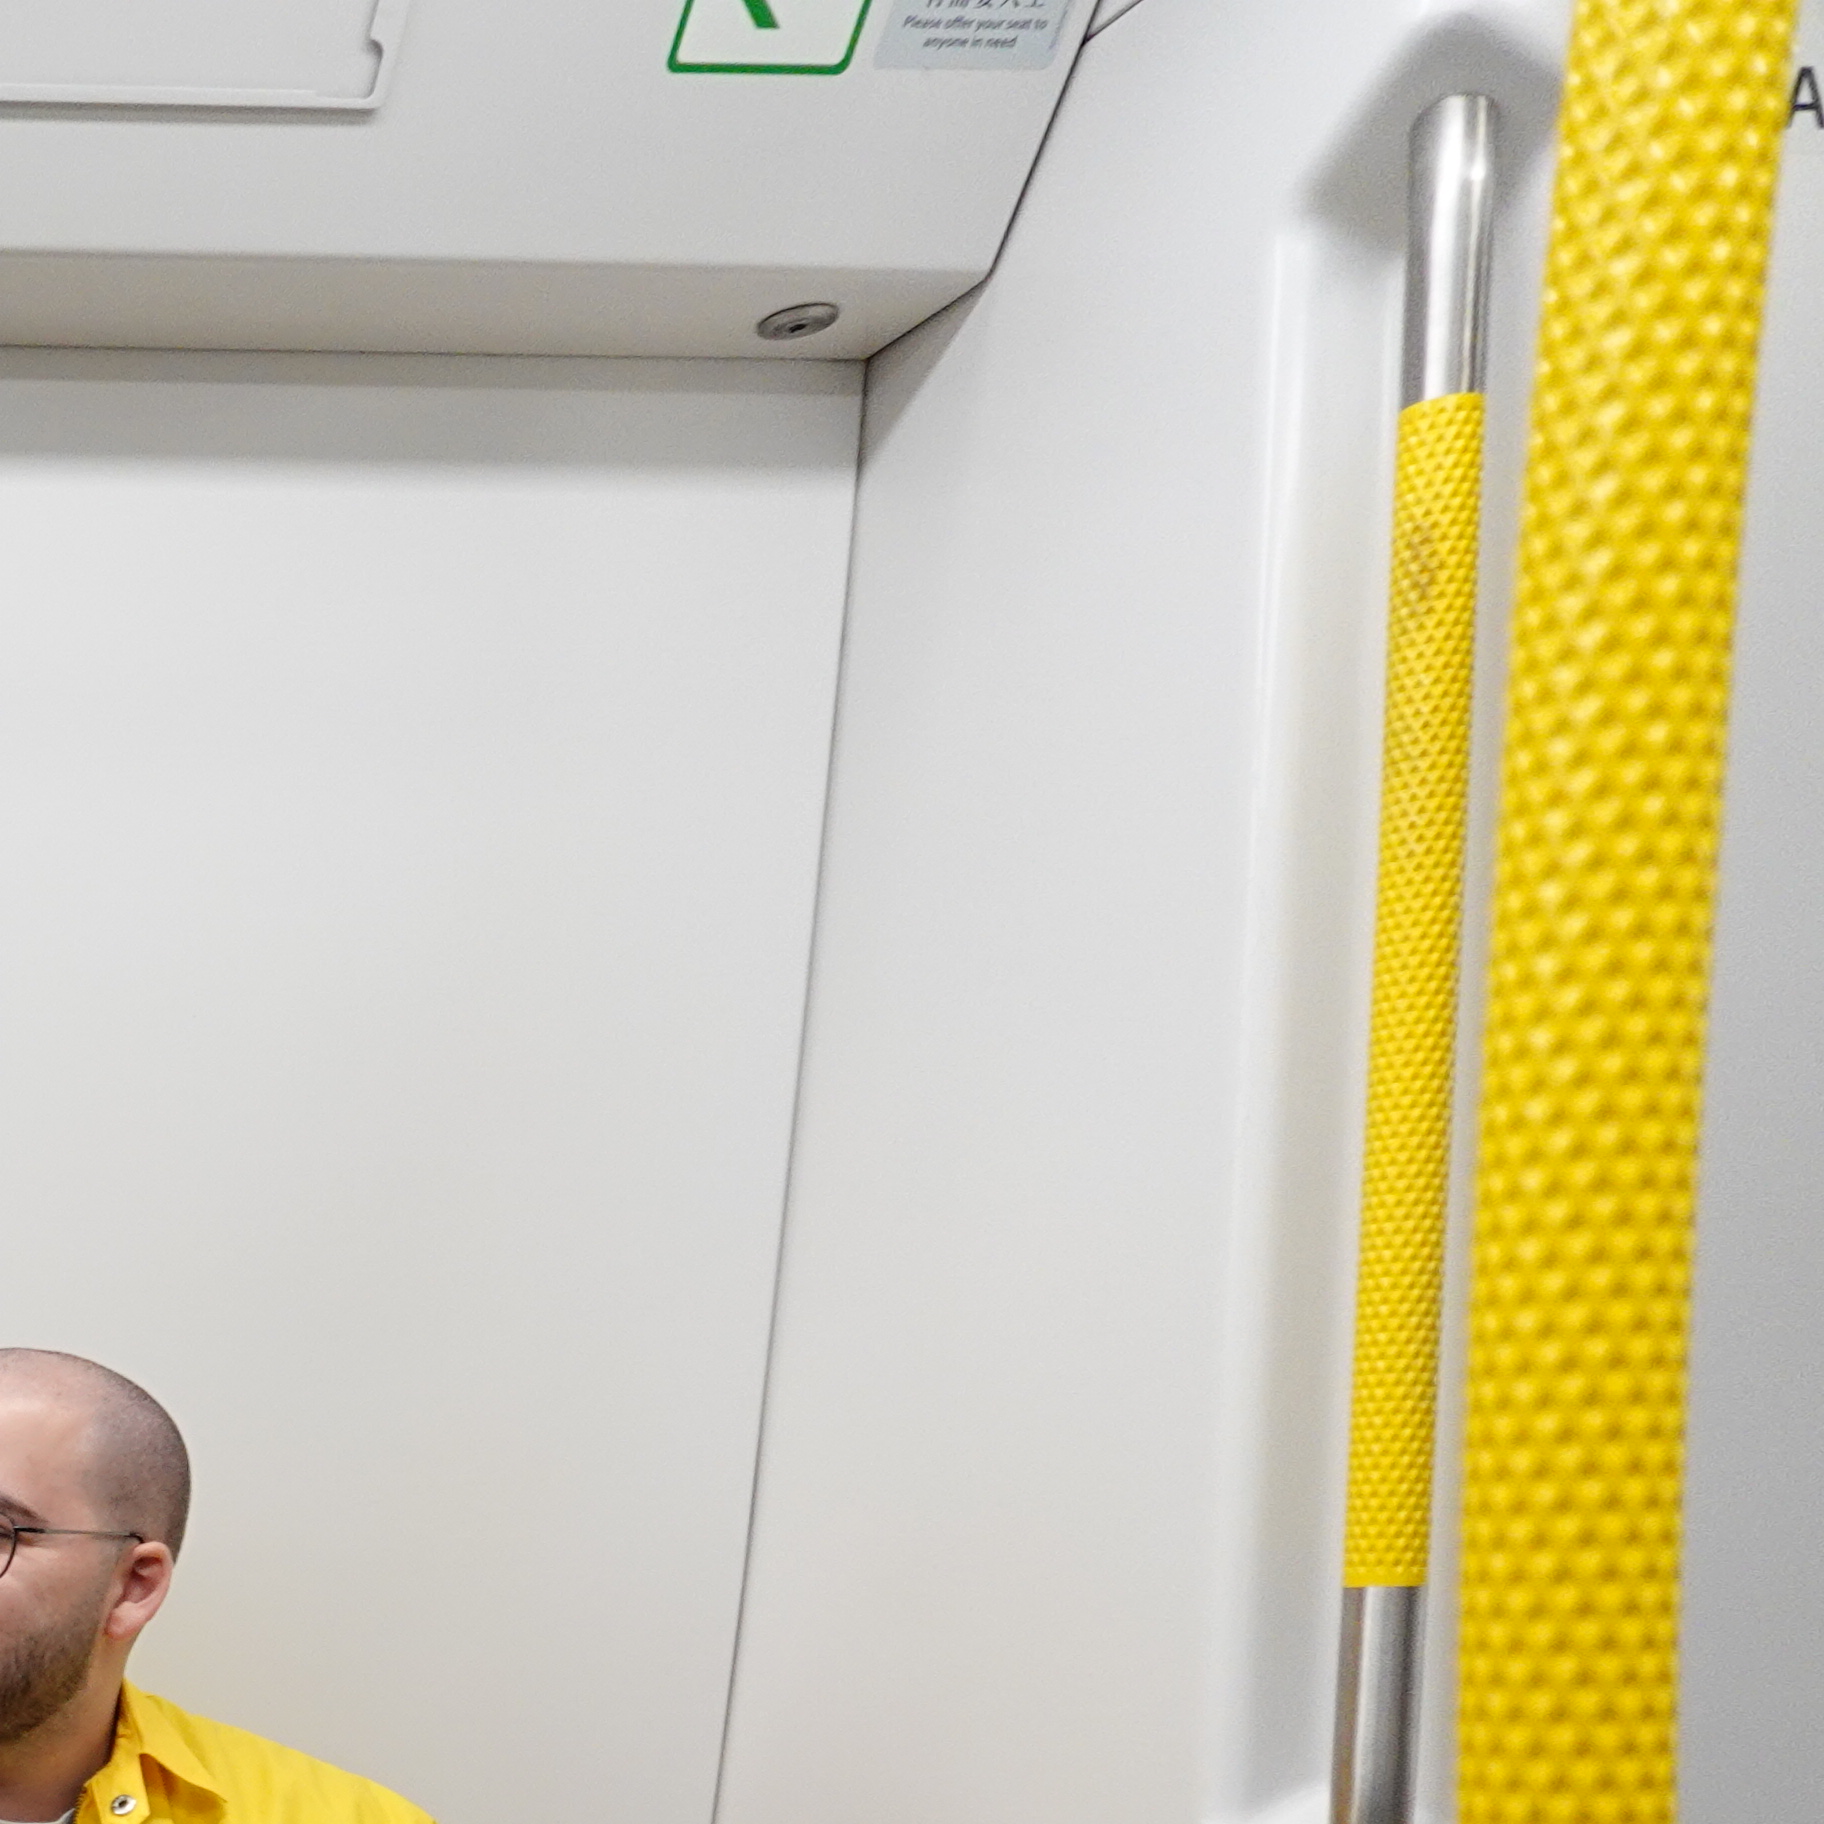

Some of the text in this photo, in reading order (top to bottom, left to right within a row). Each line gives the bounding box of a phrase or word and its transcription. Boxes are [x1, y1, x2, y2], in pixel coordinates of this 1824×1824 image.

[903, 15, 1049, 32] Please offer your seat to
[923, 35, 1019, 50] anyone in need
